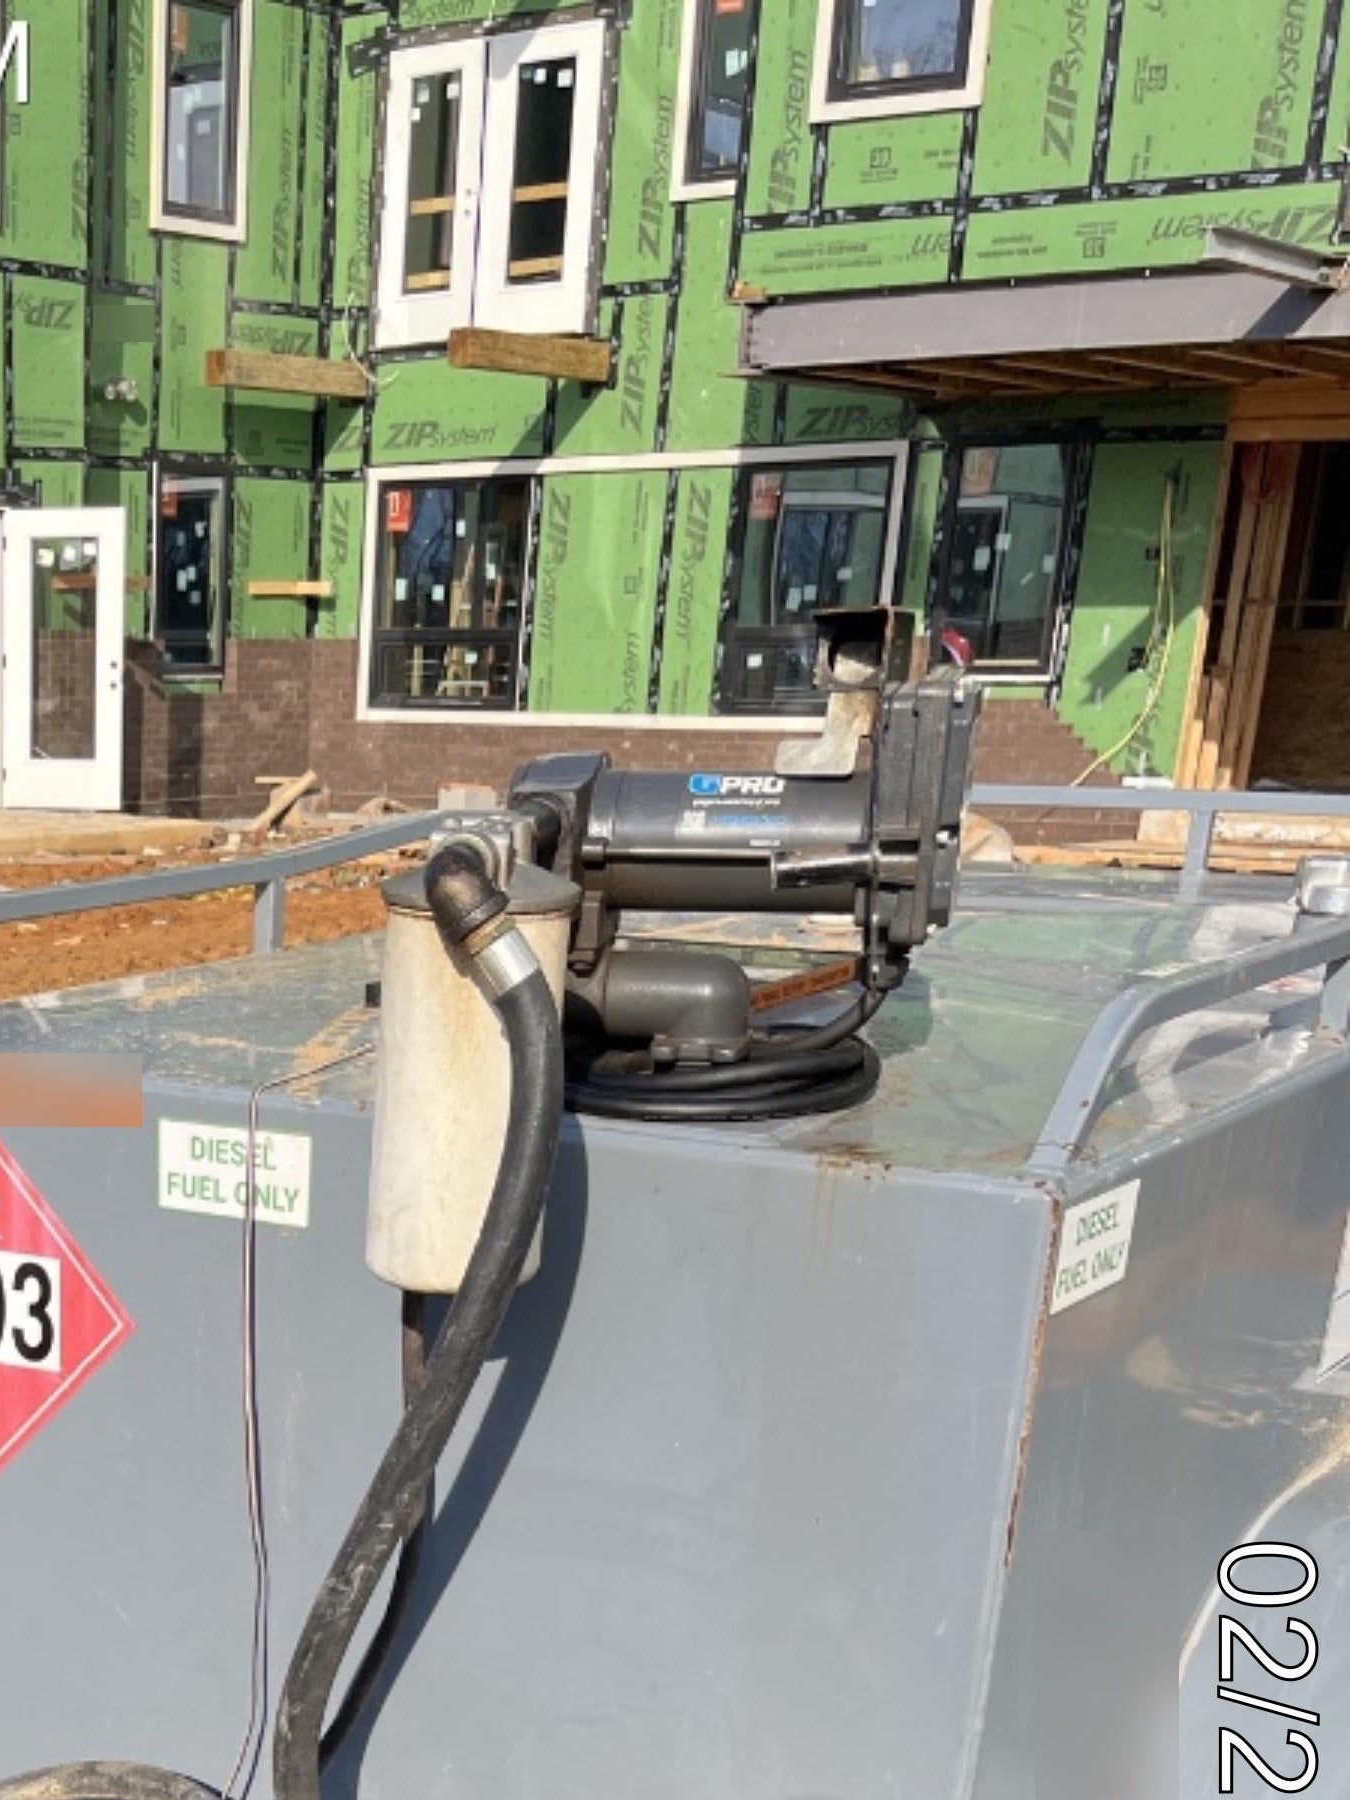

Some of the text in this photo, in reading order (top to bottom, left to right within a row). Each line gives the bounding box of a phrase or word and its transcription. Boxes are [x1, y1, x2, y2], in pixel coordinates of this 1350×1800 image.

[190, 1134, 277, 1171] DIESEL
[167, 1172, 300, 1213] FUEL ONLY
[1077, 1204, 1118, 1246] DIESEL
